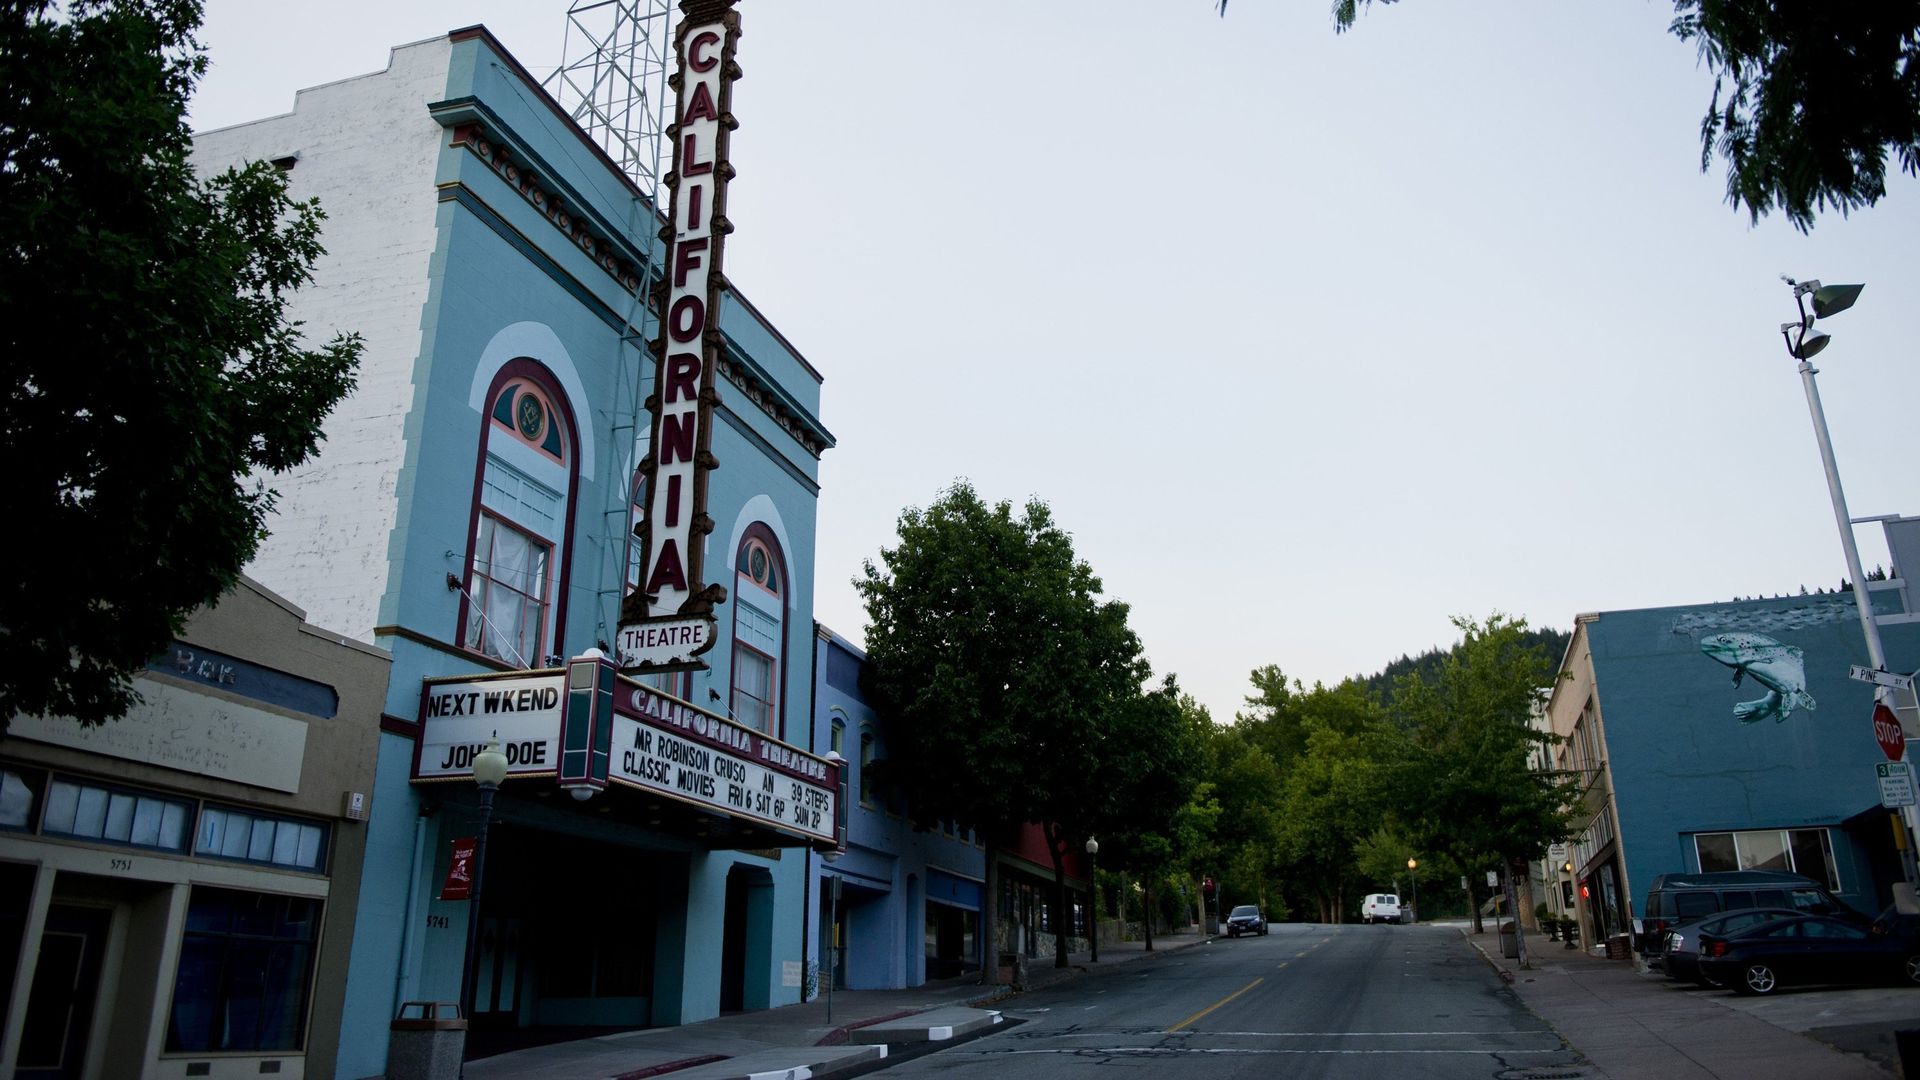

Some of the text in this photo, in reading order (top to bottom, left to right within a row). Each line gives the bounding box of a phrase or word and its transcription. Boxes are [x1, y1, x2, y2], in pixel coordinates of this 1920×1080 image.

[646, 31, 721, 593] CALIFORNIA
[625, 624, 703, 650] THEATRE
[1860, 669, 1878, 681] PINE
[427, 687, 559, 718] NEXT WKEND
[631, 688, 827, 782] CALIFORNIA THEATRE
[1875, 721, 1901, 745] STOP
[441, 741, 547, 769] JOH DOE
[634, 727, 829, 811] MR ROBINSON CRUSO AN 39 STEPS
[1879, 765, 1887, 776] 3
[623, 751, 821, 829] CLASSIC MOVIES FRI 6 SAT 6P SUN 2P
[111, 858, 132, 871] 5751
[426, 915, 449, 929] 5741
